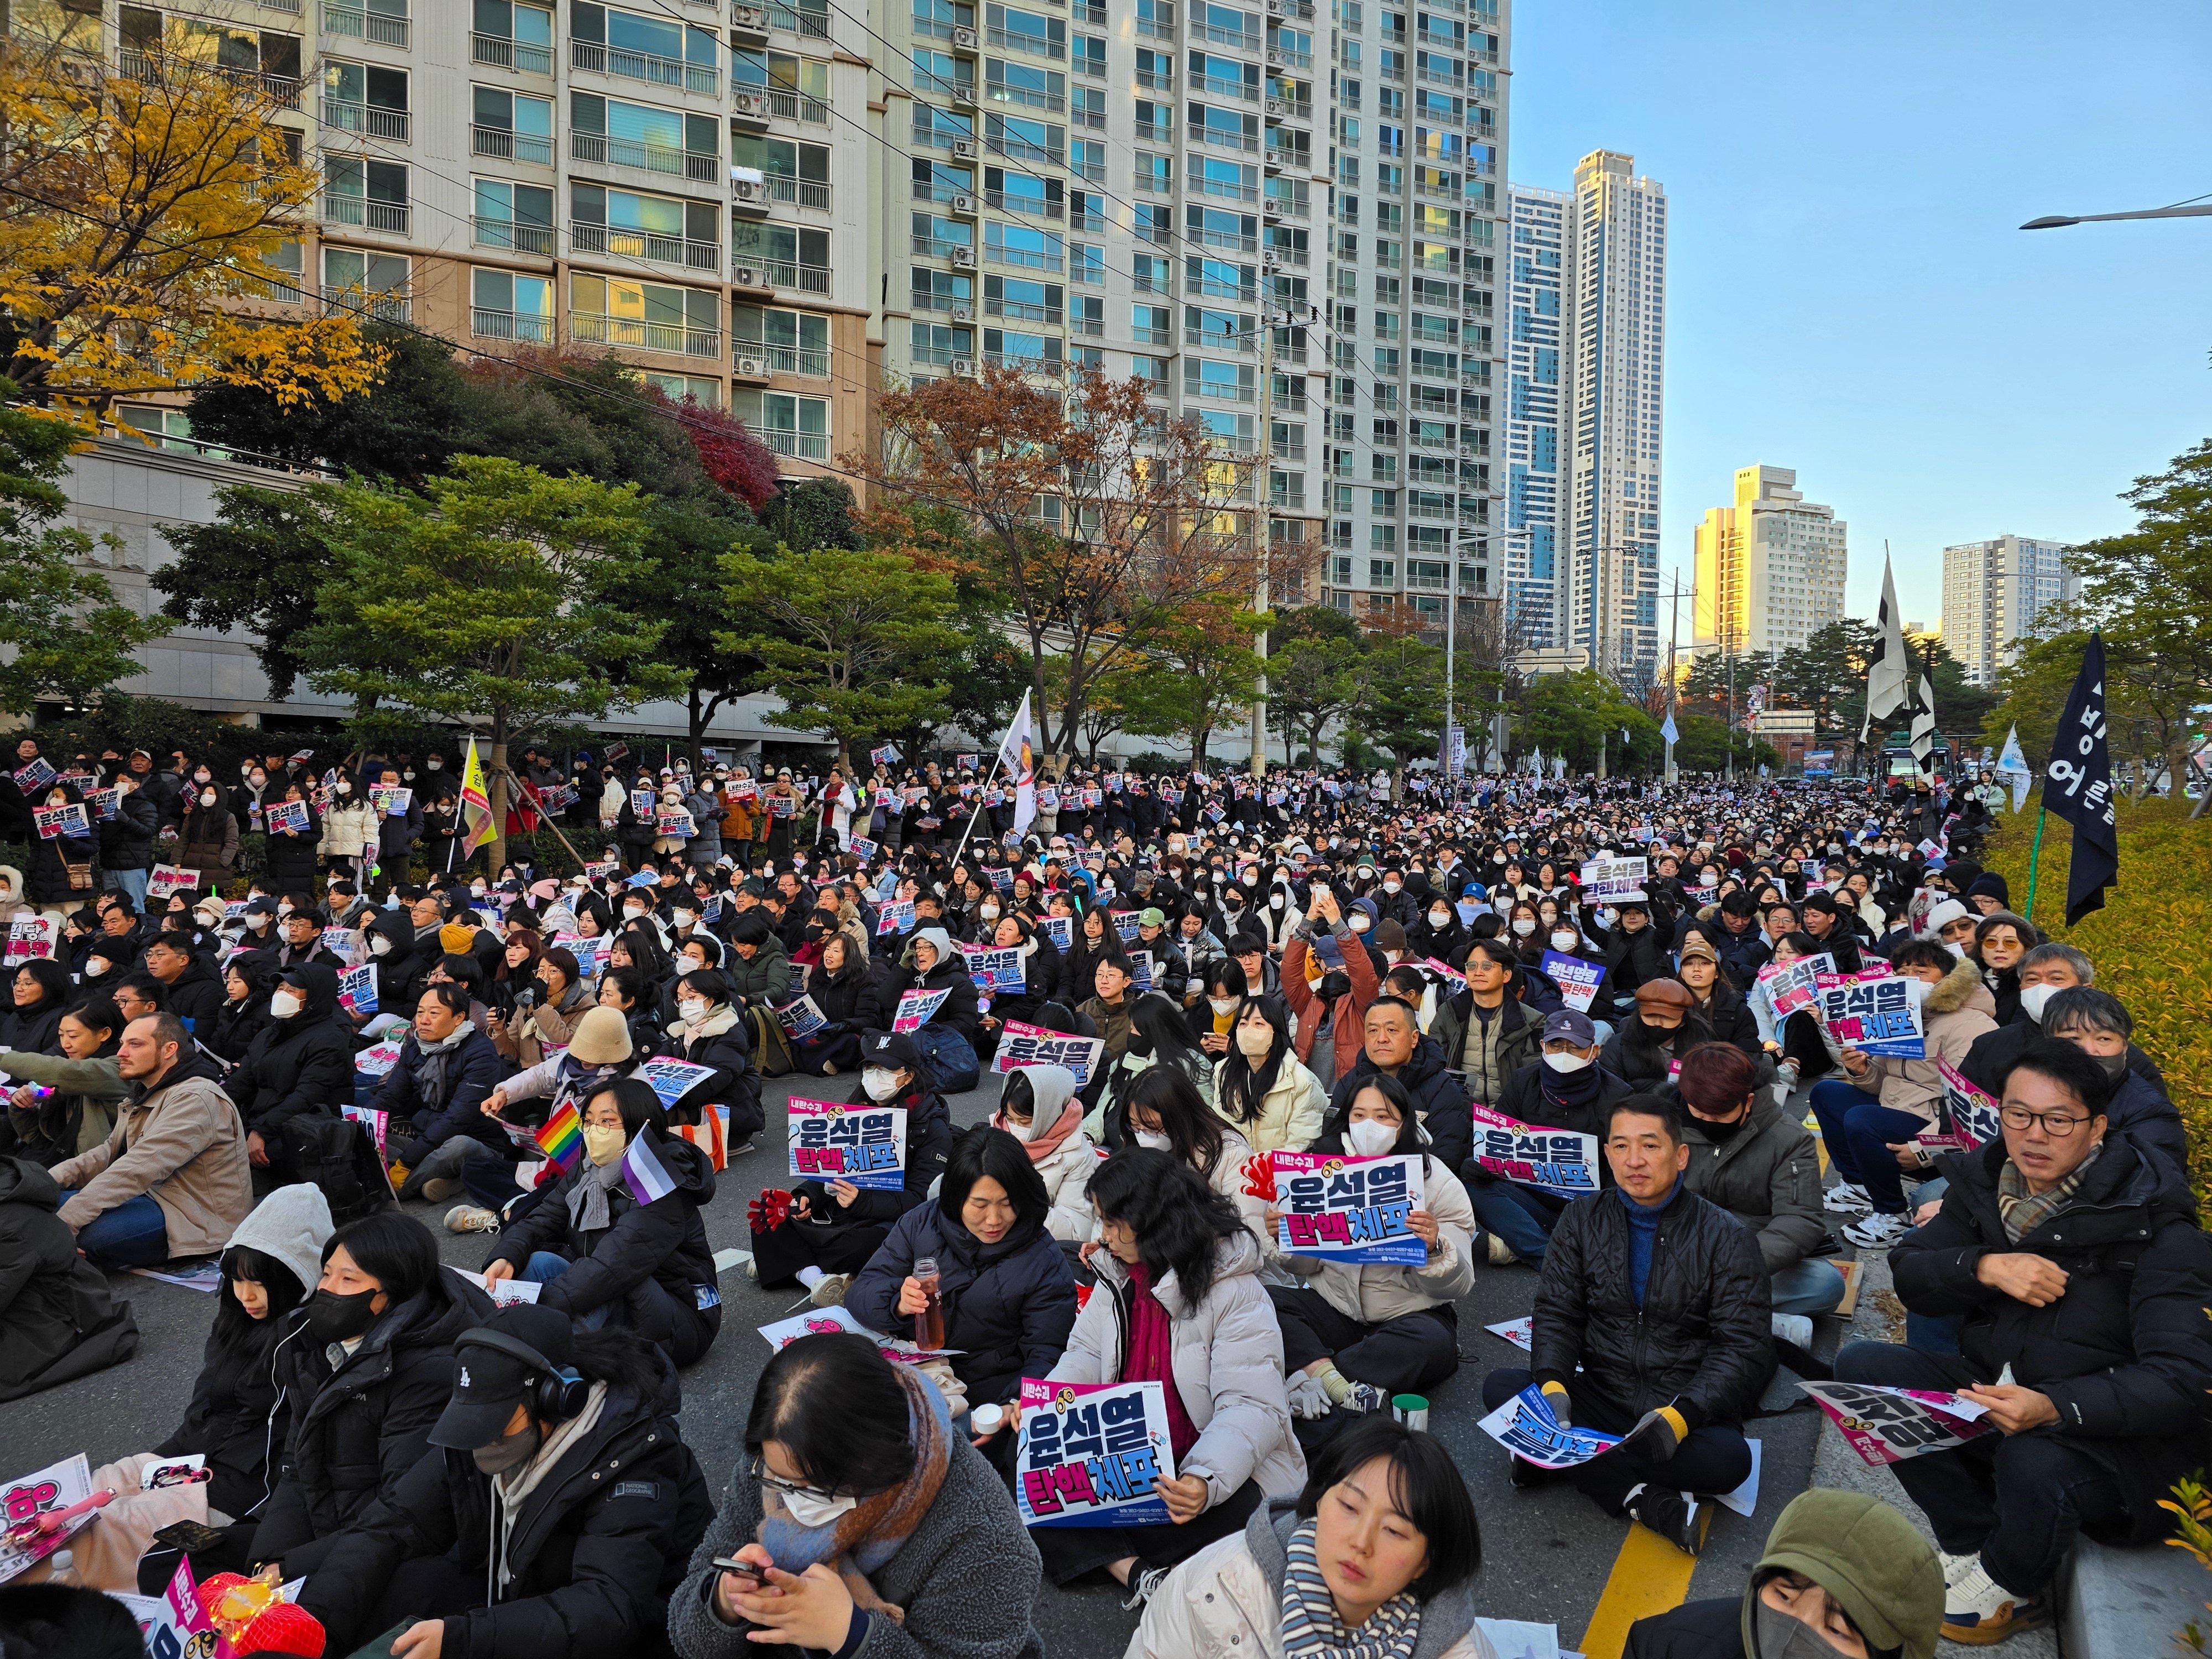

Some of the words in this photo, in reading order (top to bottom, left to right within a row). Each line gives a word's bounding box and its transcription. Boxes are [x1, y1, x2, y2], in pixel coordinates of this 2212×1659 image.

[60, 776, 95, 792] 석열
[729, 781, 753, 792] 내란수괴
[90, 789, 118, 803] 석열
[633, 794, 641, 813] 석열
[39, 806, 80, 826] 윤석열
[1597, 861, 1645, 881] 윤석열
[1587, 877, 1647, 896] 탄핵체포
[226, 904, 249, 916] 석열
[1143, 911, 1150, 919] C
[1046, 920, 1067, 935] 석열
[1113, 913, 1140, 928] 석열
[10, 921, 44, 941] 험당
[321, 932, 351, 945] 석열
[1119, 926, 1140, 939] 체포
[6, 940, 53, 959] 폭망
[558, 940, 601, 954] 윤석열
[971, 951, 1019, 973] 윤석열
[1547, 961, 1598, 983] 청년명령
[969, 968, 1022, 987] 핵체포
[1772, 957, 1828, 997] 윤석열
[337, 986, 374, 1008] 핵체포
[1571, 984, 1595, 998] 탄핵!
[1774, 982, 1818, 1015] 탄핵
[1827, 981, 1906, 1020] 윤석열
[777, 1001, 808, 1026] 석열
[901, 993, 945, 1019] 윤석열
[785, 1014, 823, 1039] 핵체포
[1008, 1020, 1037, 1035] 내란수괴
[1826, 1010, 1918, 1044] 탄핵체포
[1008, 1037, 1094, 1065] 윤석열
[648, 1062, 706, 1082] 윤석열
[649, 1074, 686, 1094] 핵체포
[791, 1099, 822, 1113] 내란수괴
[1475, 1107, 1507, 1126] 내란수괴
[377, 1112, 388, 1145] 내란수괴
[800, 1113, 893, 1149] 윤석열
[1485, 1130, 1583, 1165] 윤석열
[794, 1142, 900, 1175] 탄핵체포
[1275, 1154, 1314, 1168] 내란수괴
[1479, 1155, 1595, 1187] 탄핵체포
[1290, 1161, 1407, 1214] 윤석열
[1285, 1201, 1413, 1247] 탄핵체포
[461, 1366, 471, 1387] LA
[1022, 1383, 1050, 1400] 내란수괴
[1029, 1391, 1149, 1470] 윤석열
[1022, 1445, 1164, 1517] 탄핵체포
[175, 1563, 199, 1626] 내란수괴
